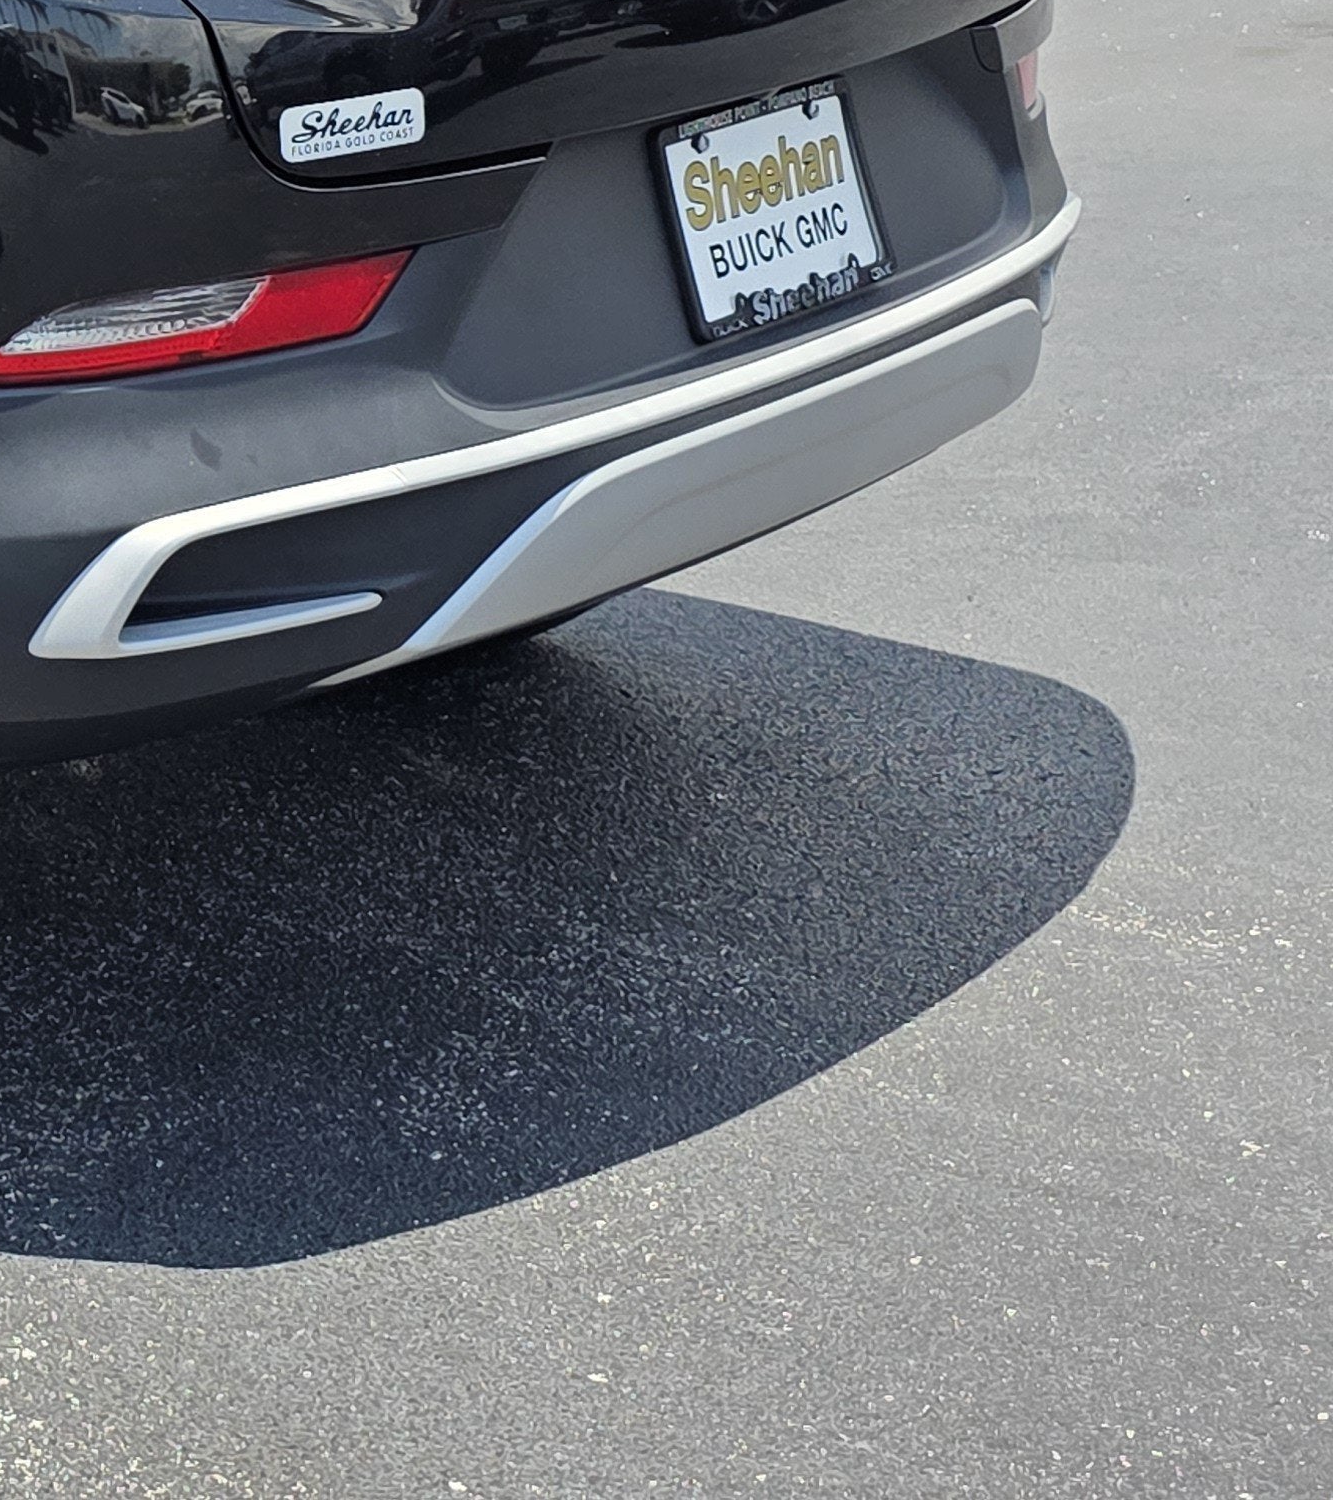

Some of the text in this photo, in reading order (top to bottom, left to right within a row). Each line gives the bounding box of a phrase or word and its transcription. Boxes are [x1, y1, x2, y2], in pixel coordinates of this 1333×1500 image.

[291, 101, 414, 143] Sheehan
[291, 127, 415, 157] FLORIDA GOLD COAST
[683, 134, 845, 232] Sheehan
[709, 203, 849, 278] BUICK GMC
[751, 266, 860, 326] Sheehan
